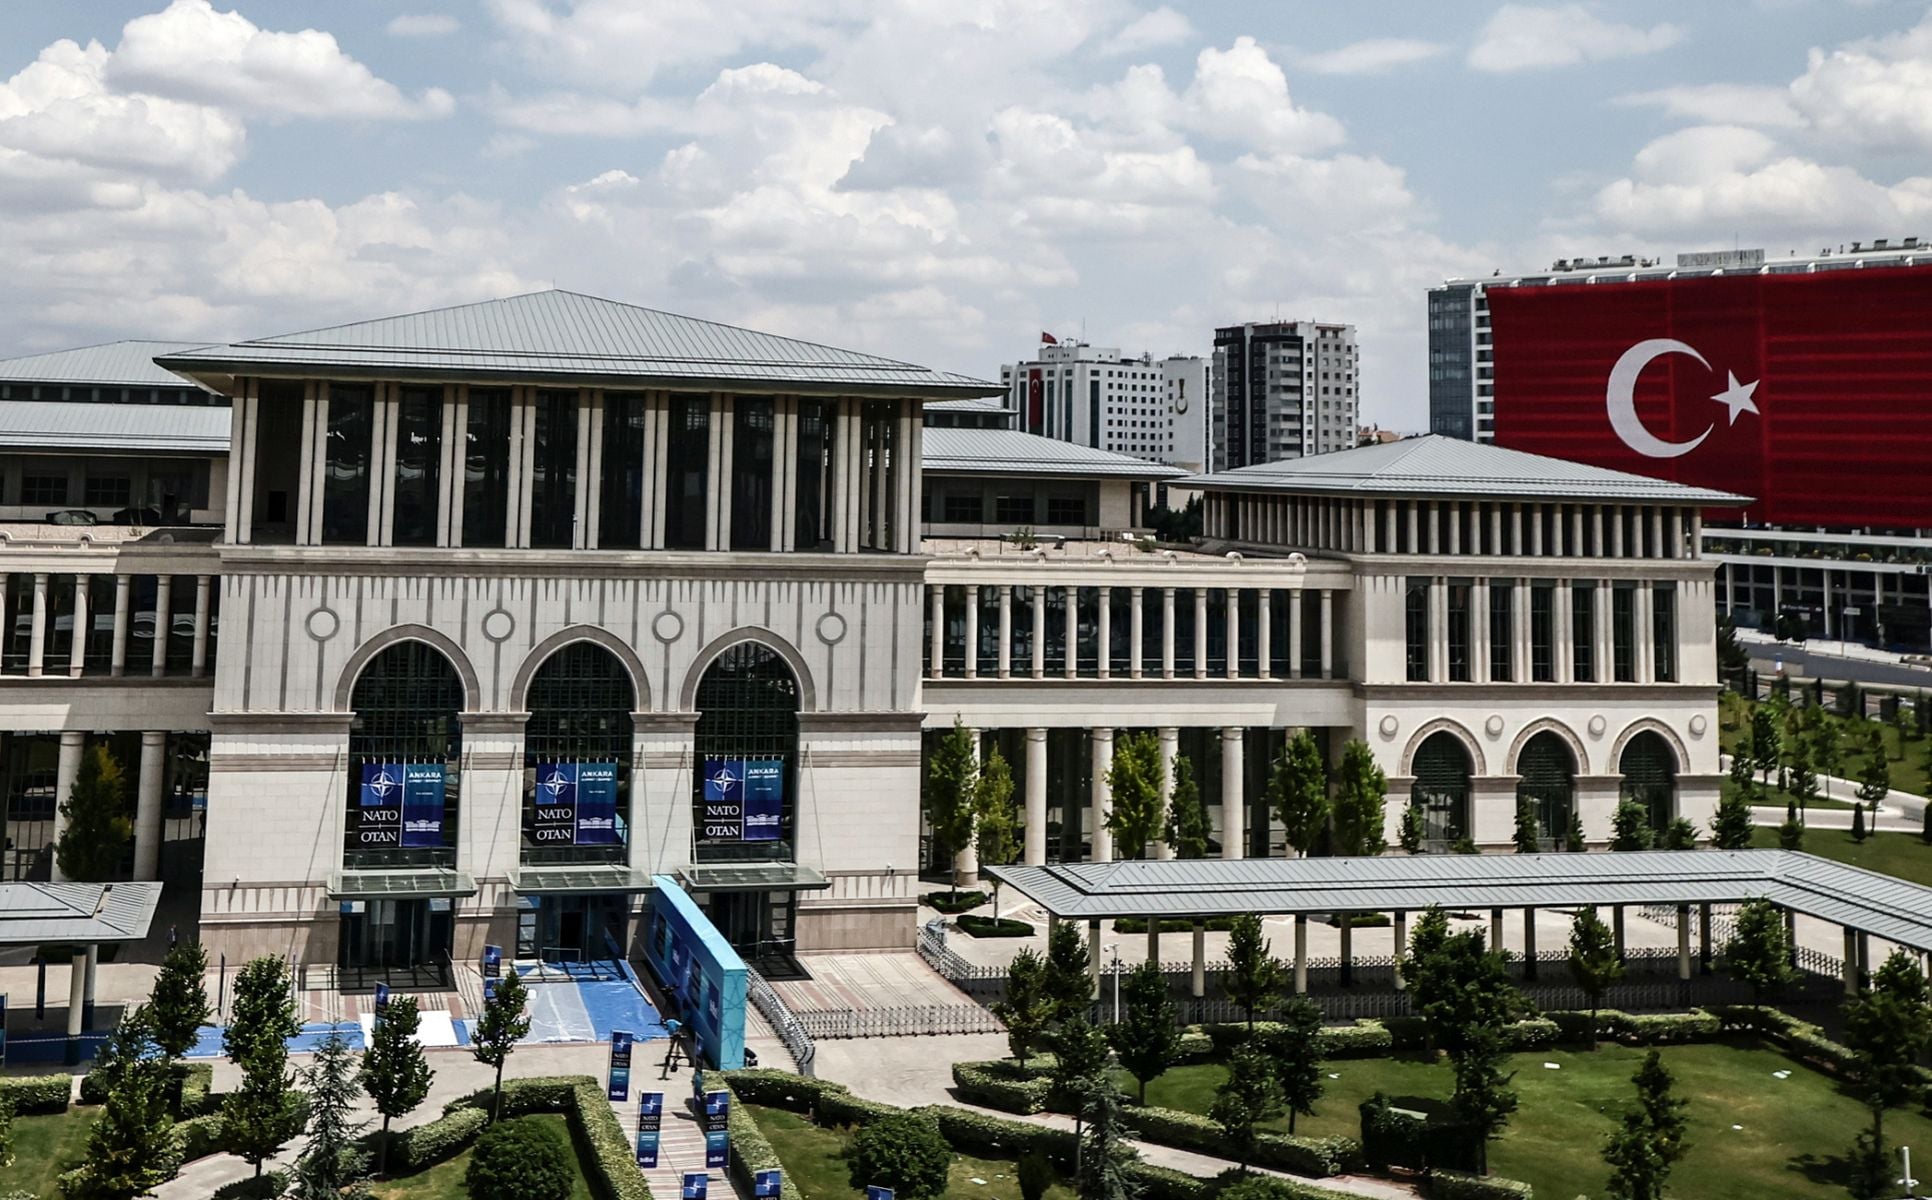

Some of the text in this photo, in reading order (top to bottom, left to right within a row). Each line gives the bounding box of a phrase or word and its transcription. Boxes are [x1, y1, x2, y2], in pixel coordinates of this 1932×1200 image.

[362, 810, 398, 821] NATO
[537, 808, 572, 819] NATO
[706, 805, 740, 816] NATO
[536, 829, 571, 840] OTAN
[705, 825, 739, 836] OTAN
[360, 831, 397, 842] OTAN
